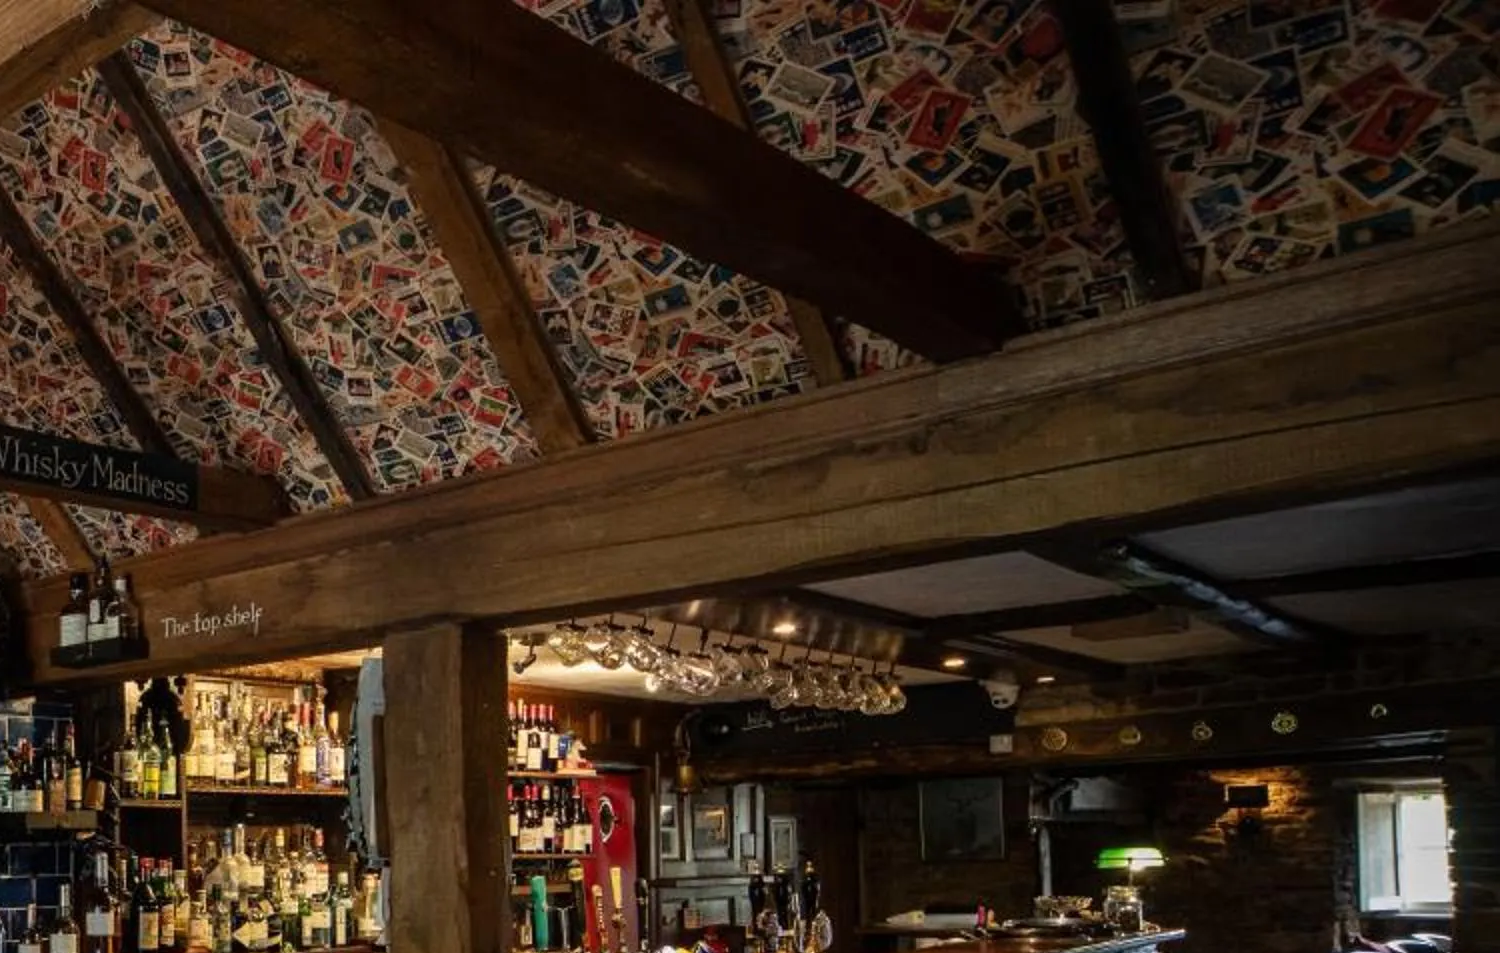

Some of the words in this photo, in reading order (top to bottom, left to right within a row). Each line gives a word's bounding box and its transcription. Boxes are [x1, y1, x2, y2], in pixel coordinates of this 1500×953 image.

[92, 453, 190, 504] Madness
[161, 617, 192, 639] The
[194, 611, 221, 637] top
[223, 602, 263, 637] shelf
